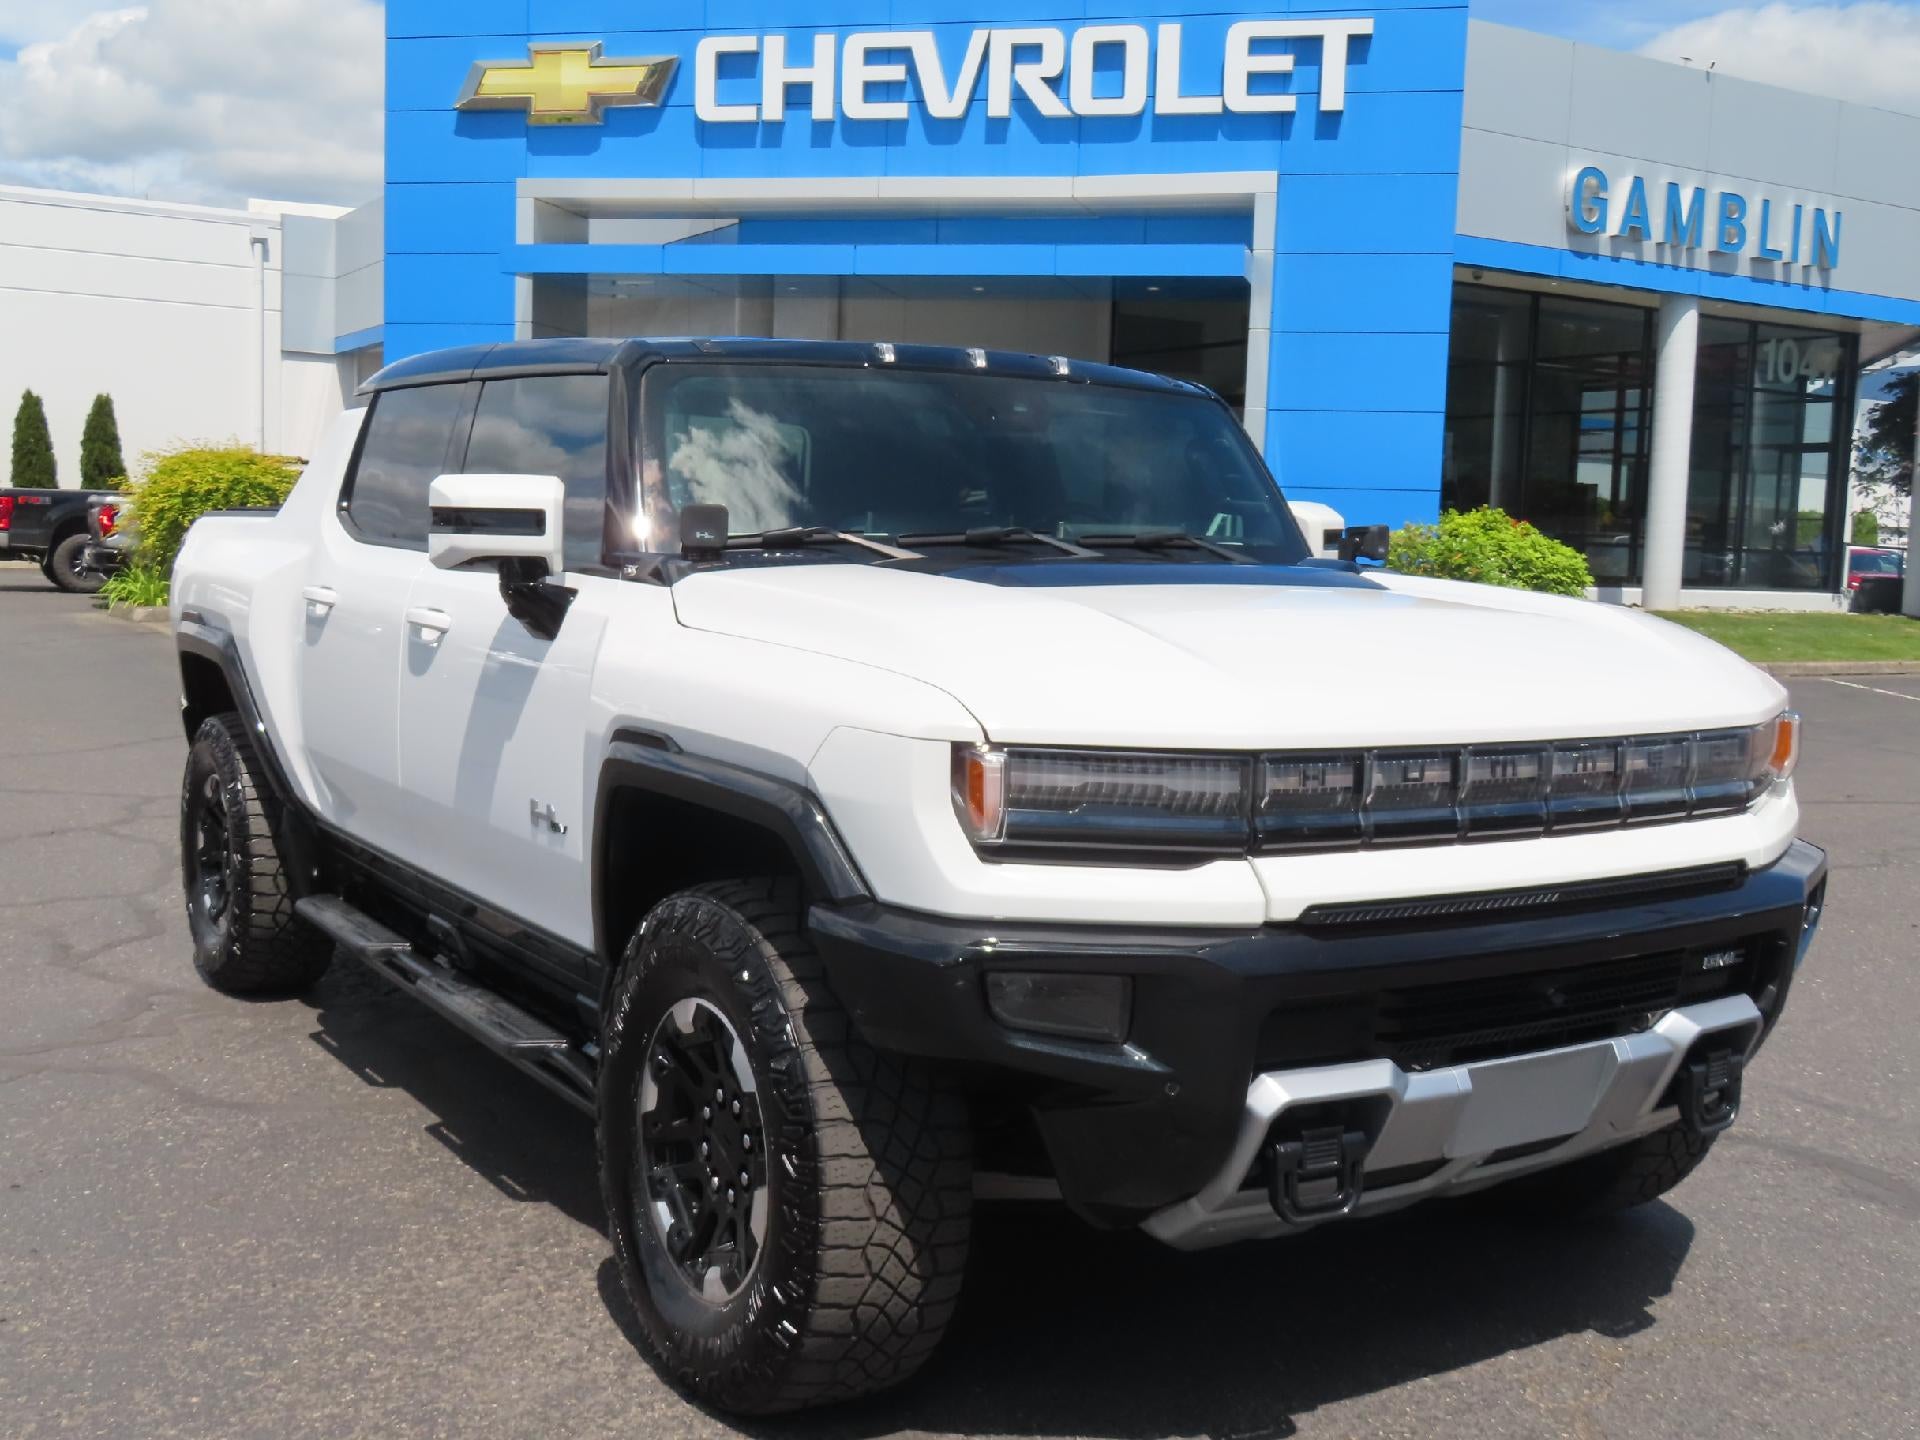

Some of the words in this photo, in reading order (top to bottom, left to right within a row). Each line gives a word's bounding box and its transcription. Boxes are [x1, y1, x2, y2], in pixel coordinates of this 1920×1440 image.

[694, 18, 1374, 122] CHEVROLET
[1571, 166, 1843, 270] GAMBLIN
[1301, 745, 1727, 788] HUMME
[1702, 949, 1745, 970] GMC
